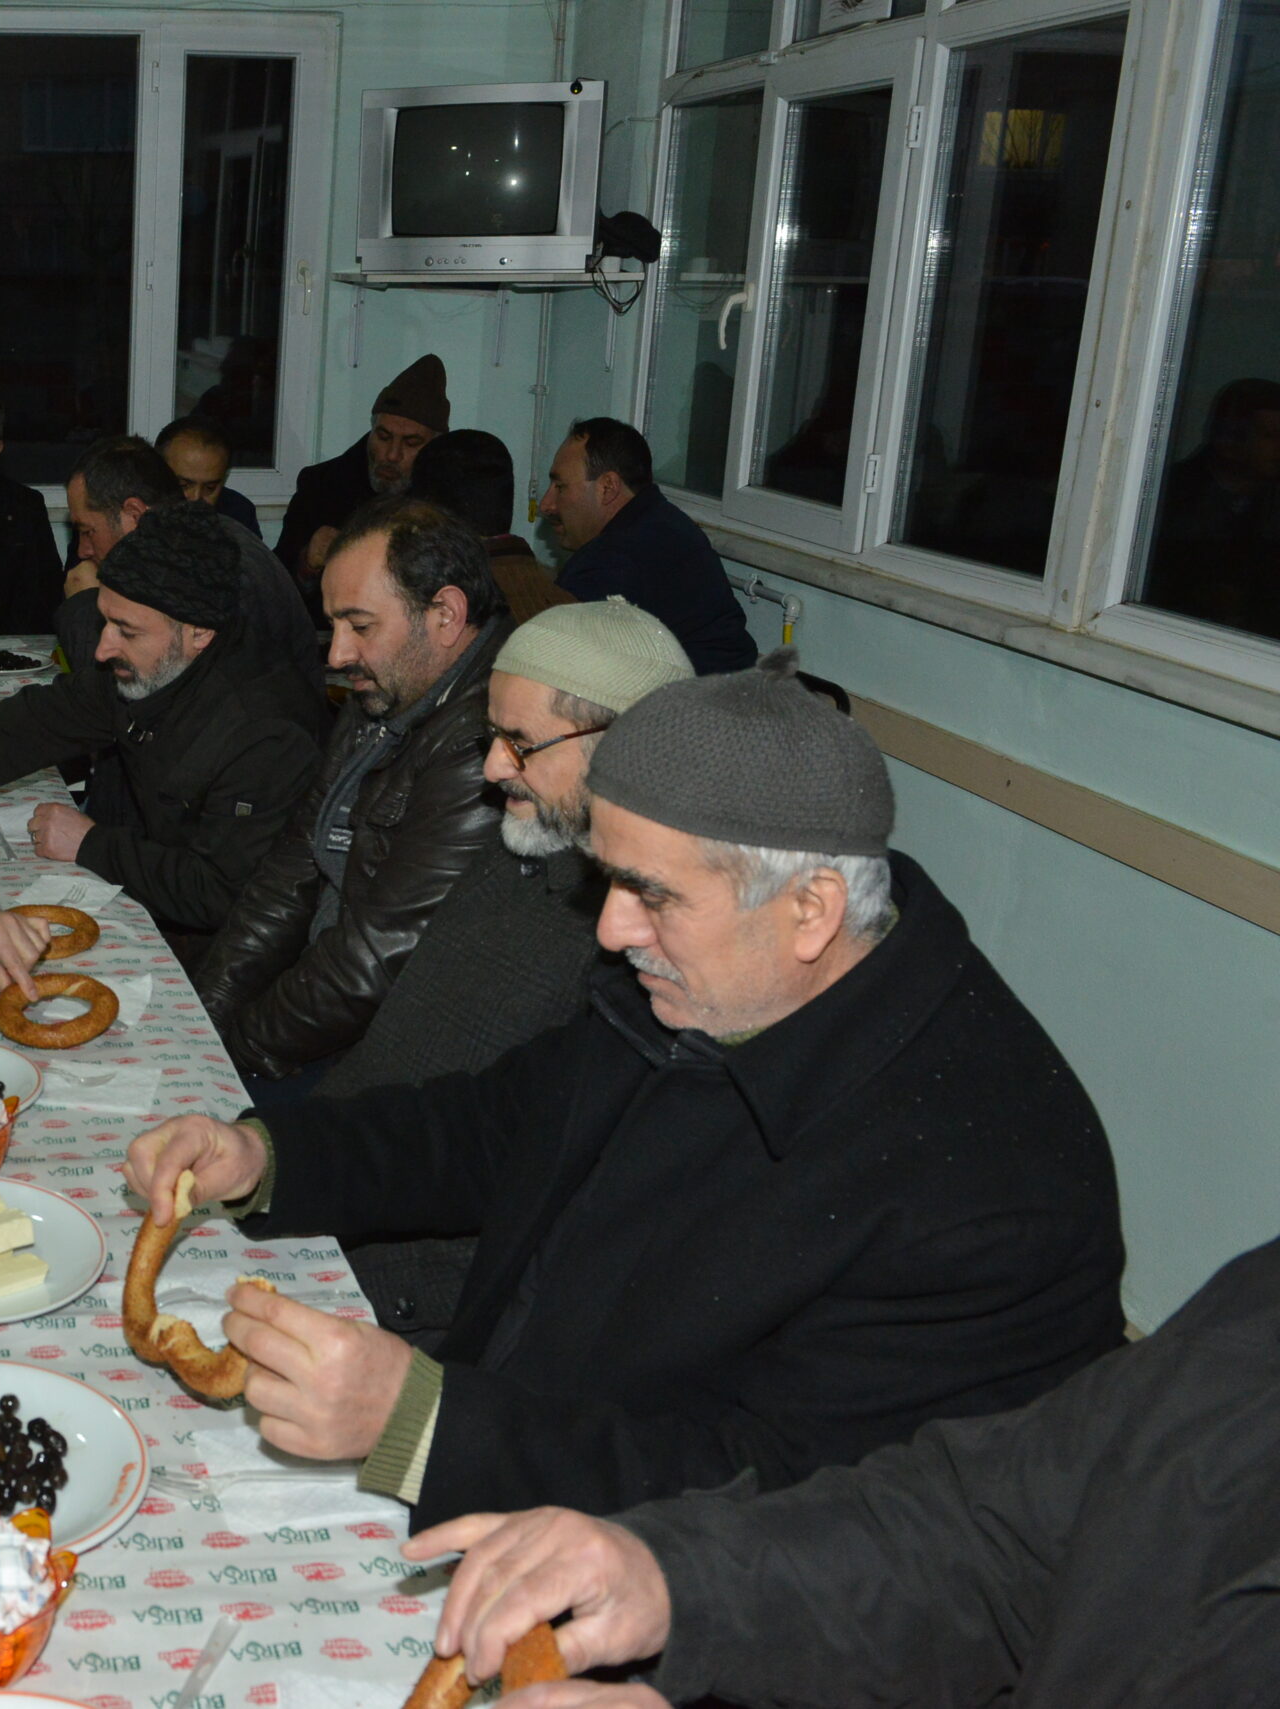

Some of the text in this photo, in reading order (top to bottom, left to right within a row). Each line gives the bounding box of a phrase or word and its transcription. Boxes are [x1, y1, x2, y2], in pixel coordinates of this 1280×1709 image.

[48, 1165, 94, 1178] BURSA
[176, 1245, 228, 1260] BURSA
[289, 1247, 340, 1262] BURSA
[118, 1532, 184, 1552] BURSA
[265, 1526, 332, 1546] BURSA
[210, 1565, 278, 1585] BURSA
[360, 1556, 427, 1579] BURSA
[78, 1573, 126, 1593] BURS
[133, 1605, 204, 1626] BURSA
[290, 1597, 361, 1616] BURSA
[231, 1641, 304, 1663] BURSA
[68, 1652, 142, 1674] BURSA
